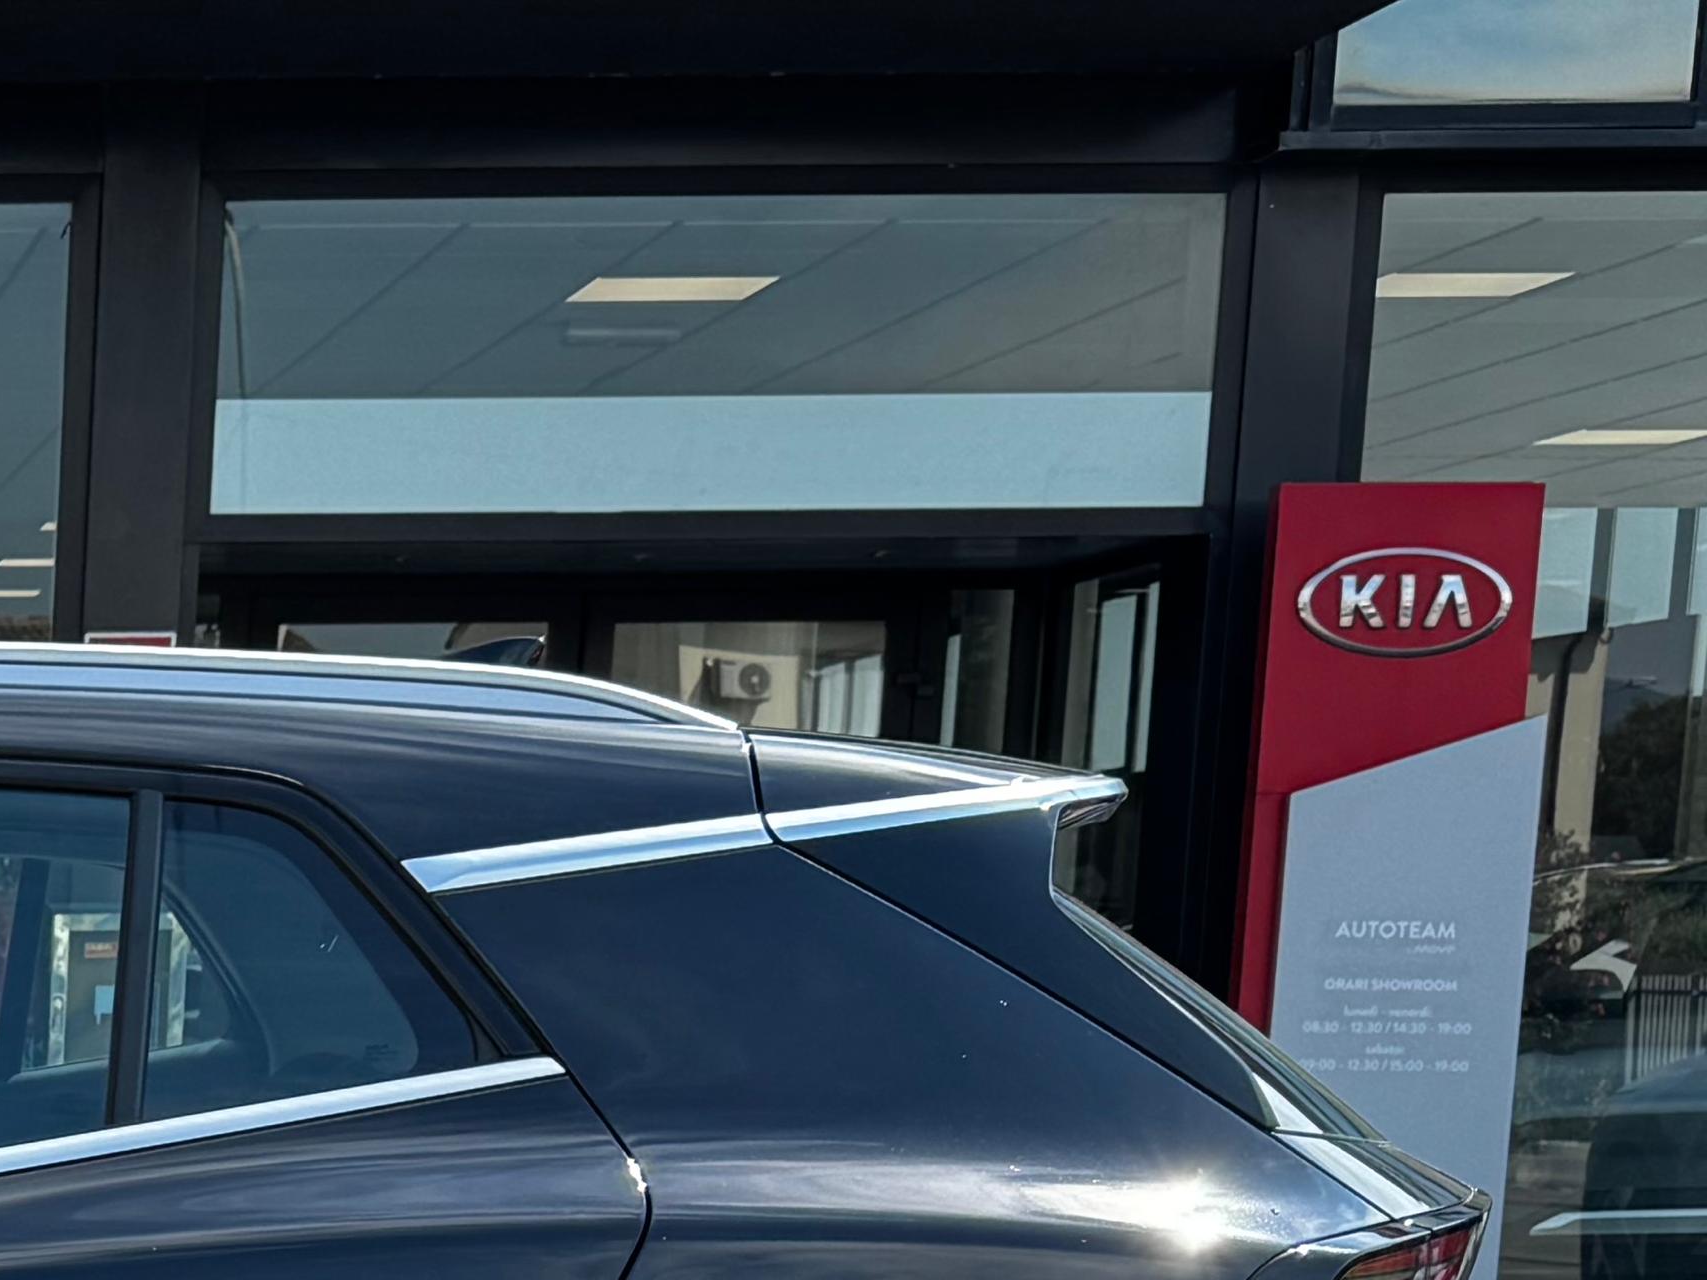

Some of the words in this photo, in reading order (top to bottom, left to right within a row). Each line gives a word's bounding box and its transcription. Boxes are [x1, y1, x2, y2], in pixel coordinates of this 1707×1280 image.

[1338, 574, 1473, 628] KIA
[1335, 920, 1456, 939] AUTOTEAM
[1324, 977, 1368, 991] ORARI
[1372, 978, 1458, 992] SHOWROOM
